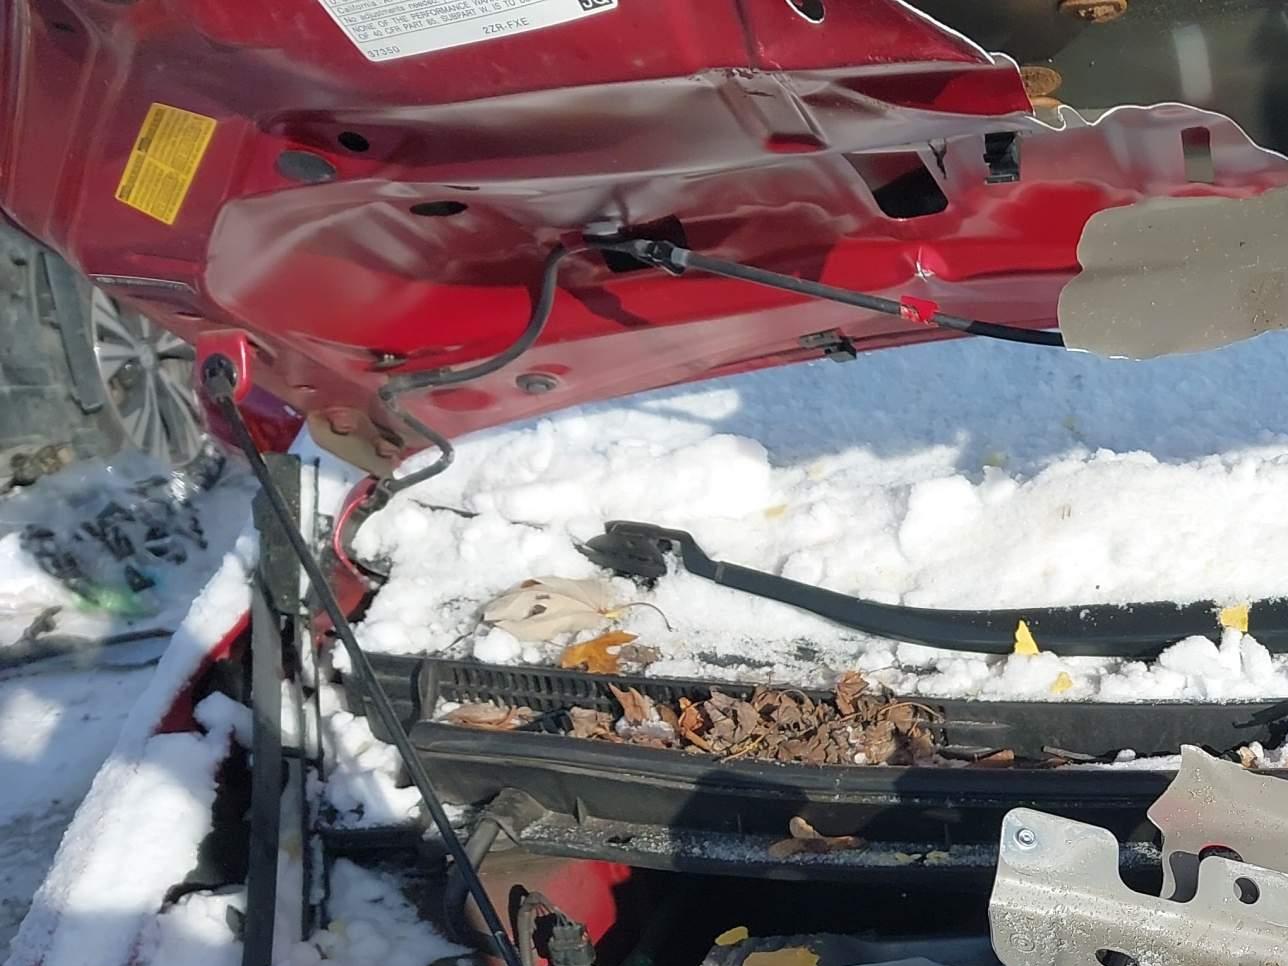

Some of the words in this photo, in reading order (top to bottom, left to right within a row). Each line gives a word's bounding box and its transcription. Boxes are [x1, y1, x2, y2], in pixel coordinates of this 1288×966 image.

[352, 23, 375, 32] NONE
[377, 19, 390, 28] OF
[393, 15, 410, 24] THE
[411, 2, 471, 19] PERFORMANCE
[403, 20, 424, 31] PART
[482, 17, 530, 35] 2ZR-FXE
